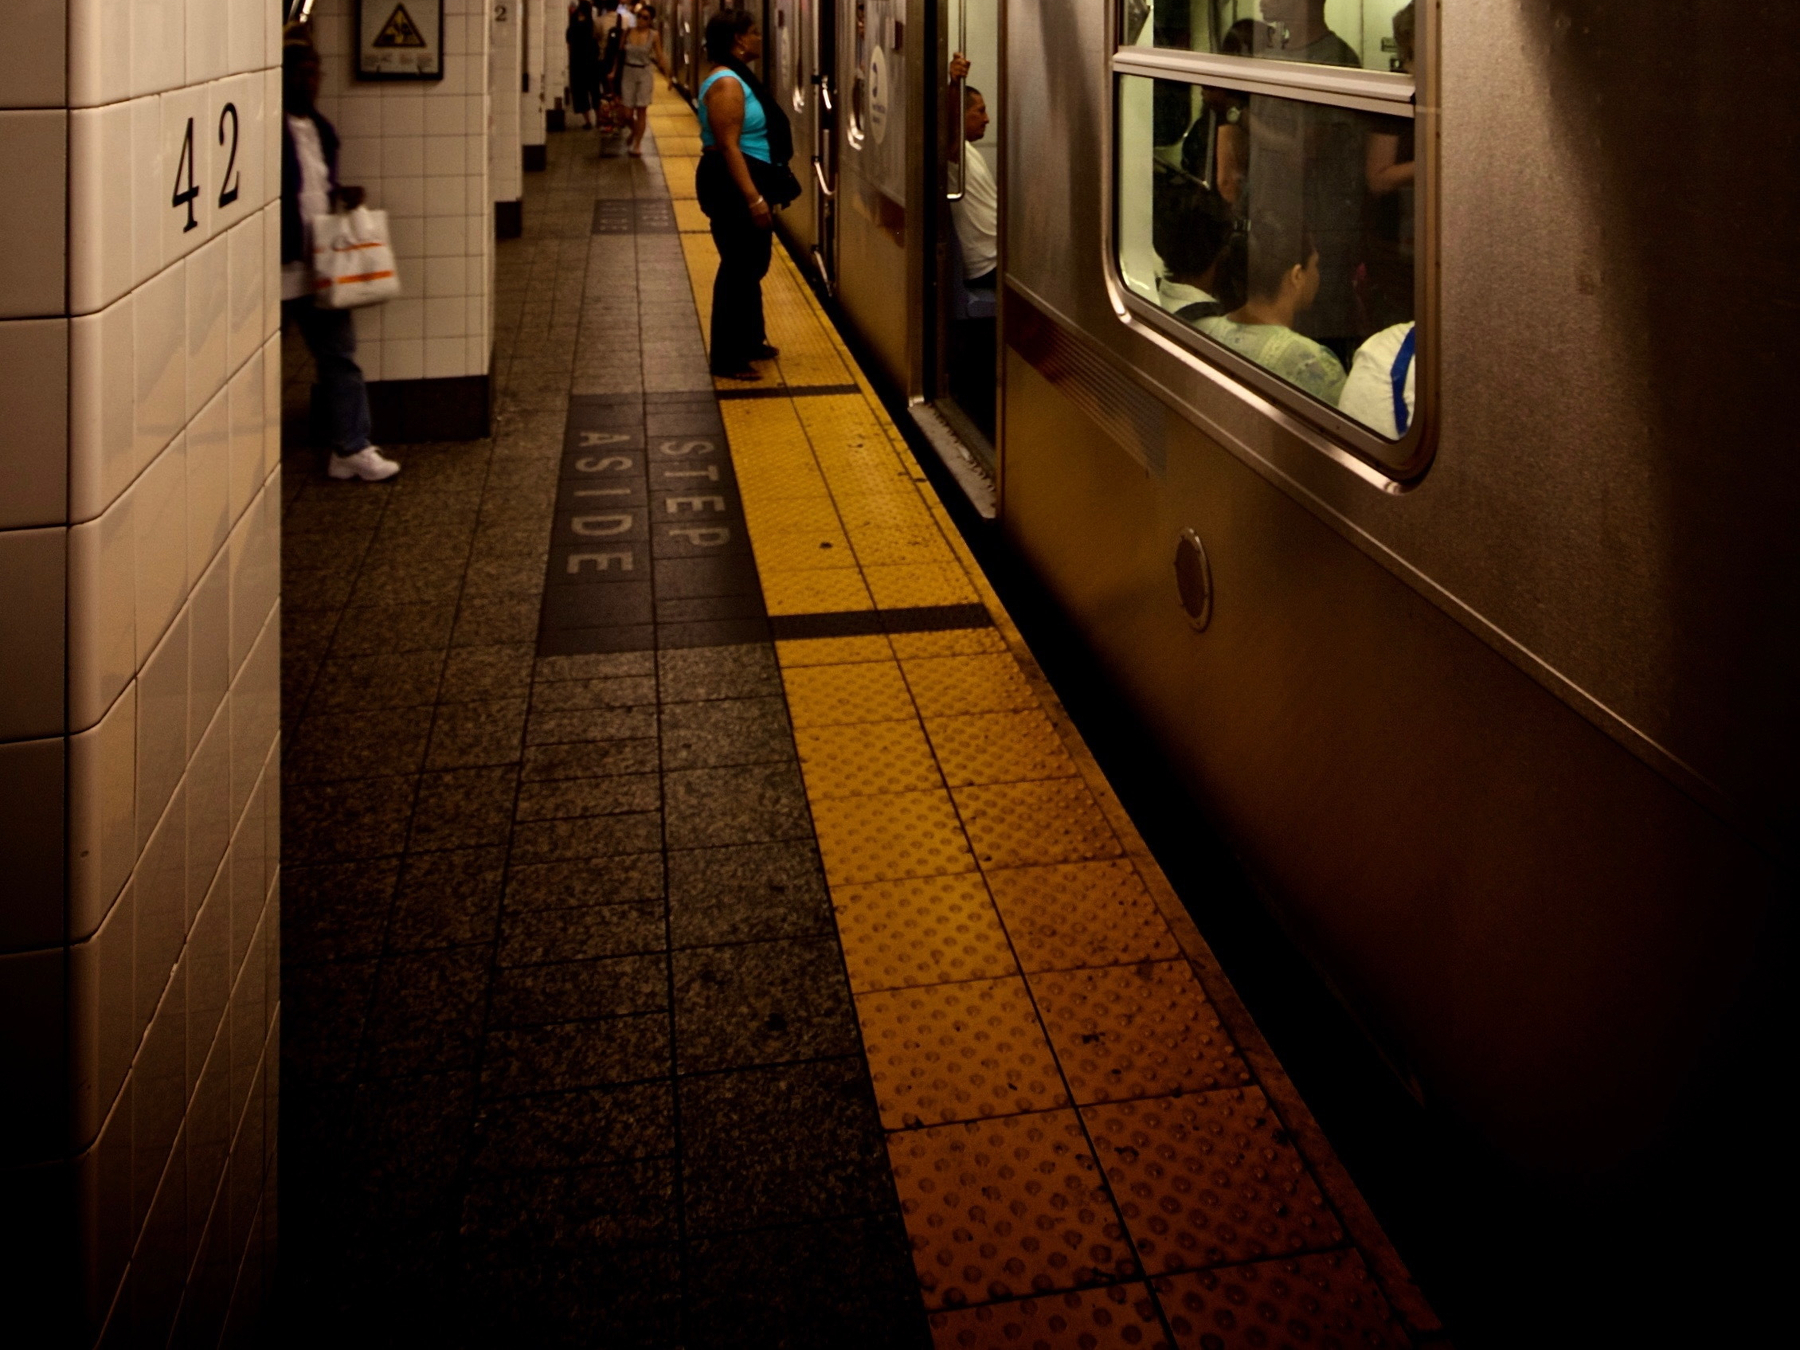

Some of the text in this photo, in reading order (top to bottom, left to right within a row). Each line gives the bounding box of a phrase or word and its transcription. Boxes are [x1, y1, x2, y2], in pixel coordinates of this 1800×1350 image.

[172, 102, 239, 233] 42
[566, 430, 634, 574] ASIDE
[660, 440, 731, 547] STEP
